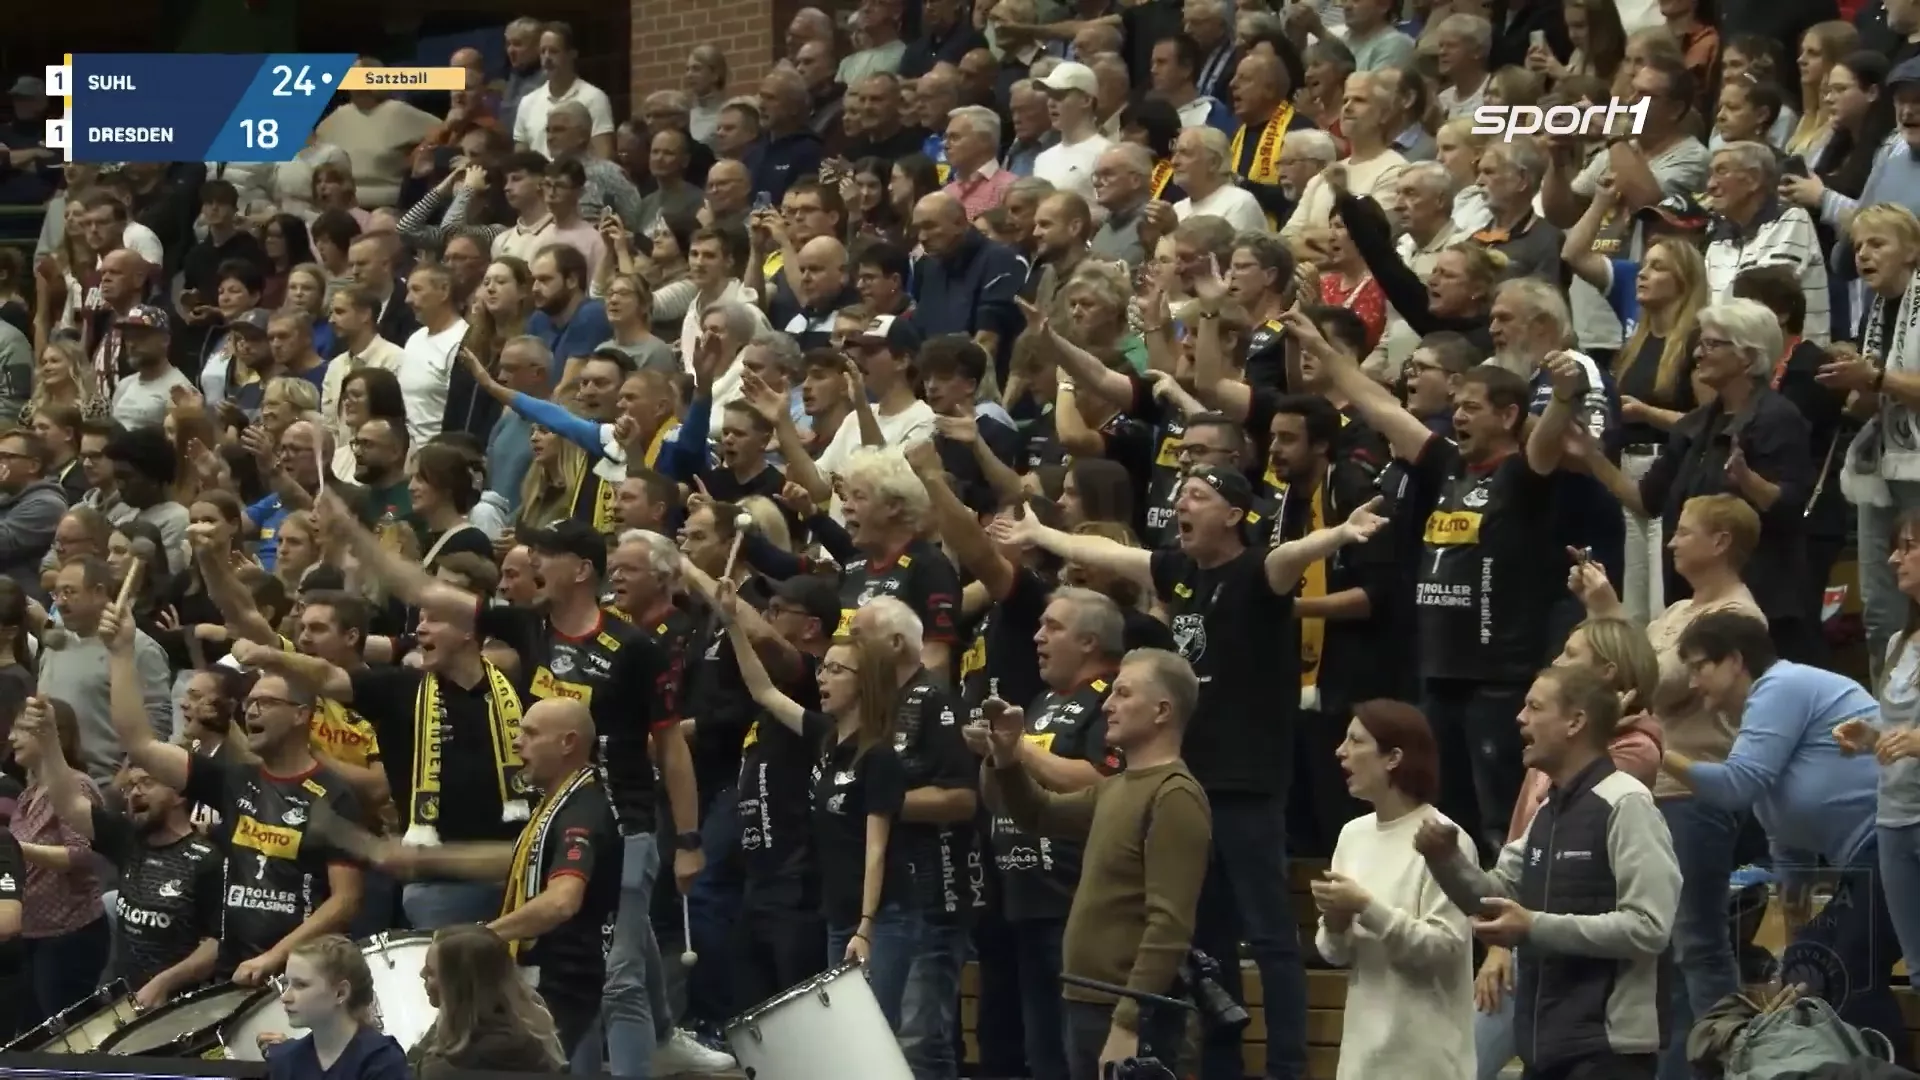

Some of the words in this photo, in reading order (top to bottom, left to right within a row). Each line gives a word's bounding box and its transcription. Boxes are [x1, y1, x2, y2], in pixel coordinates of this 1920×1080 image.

[1424, 583, 1471, 596] ROLLER
[1480, 557, 1494, 644] hotel-suhl.de
[252, 826, 291, 847] LOTTO
[245, 887, 297, 902] ROLLER
[243, 897, 296, 914] LEASING
[124, 906, 171, 929] LOTTO
